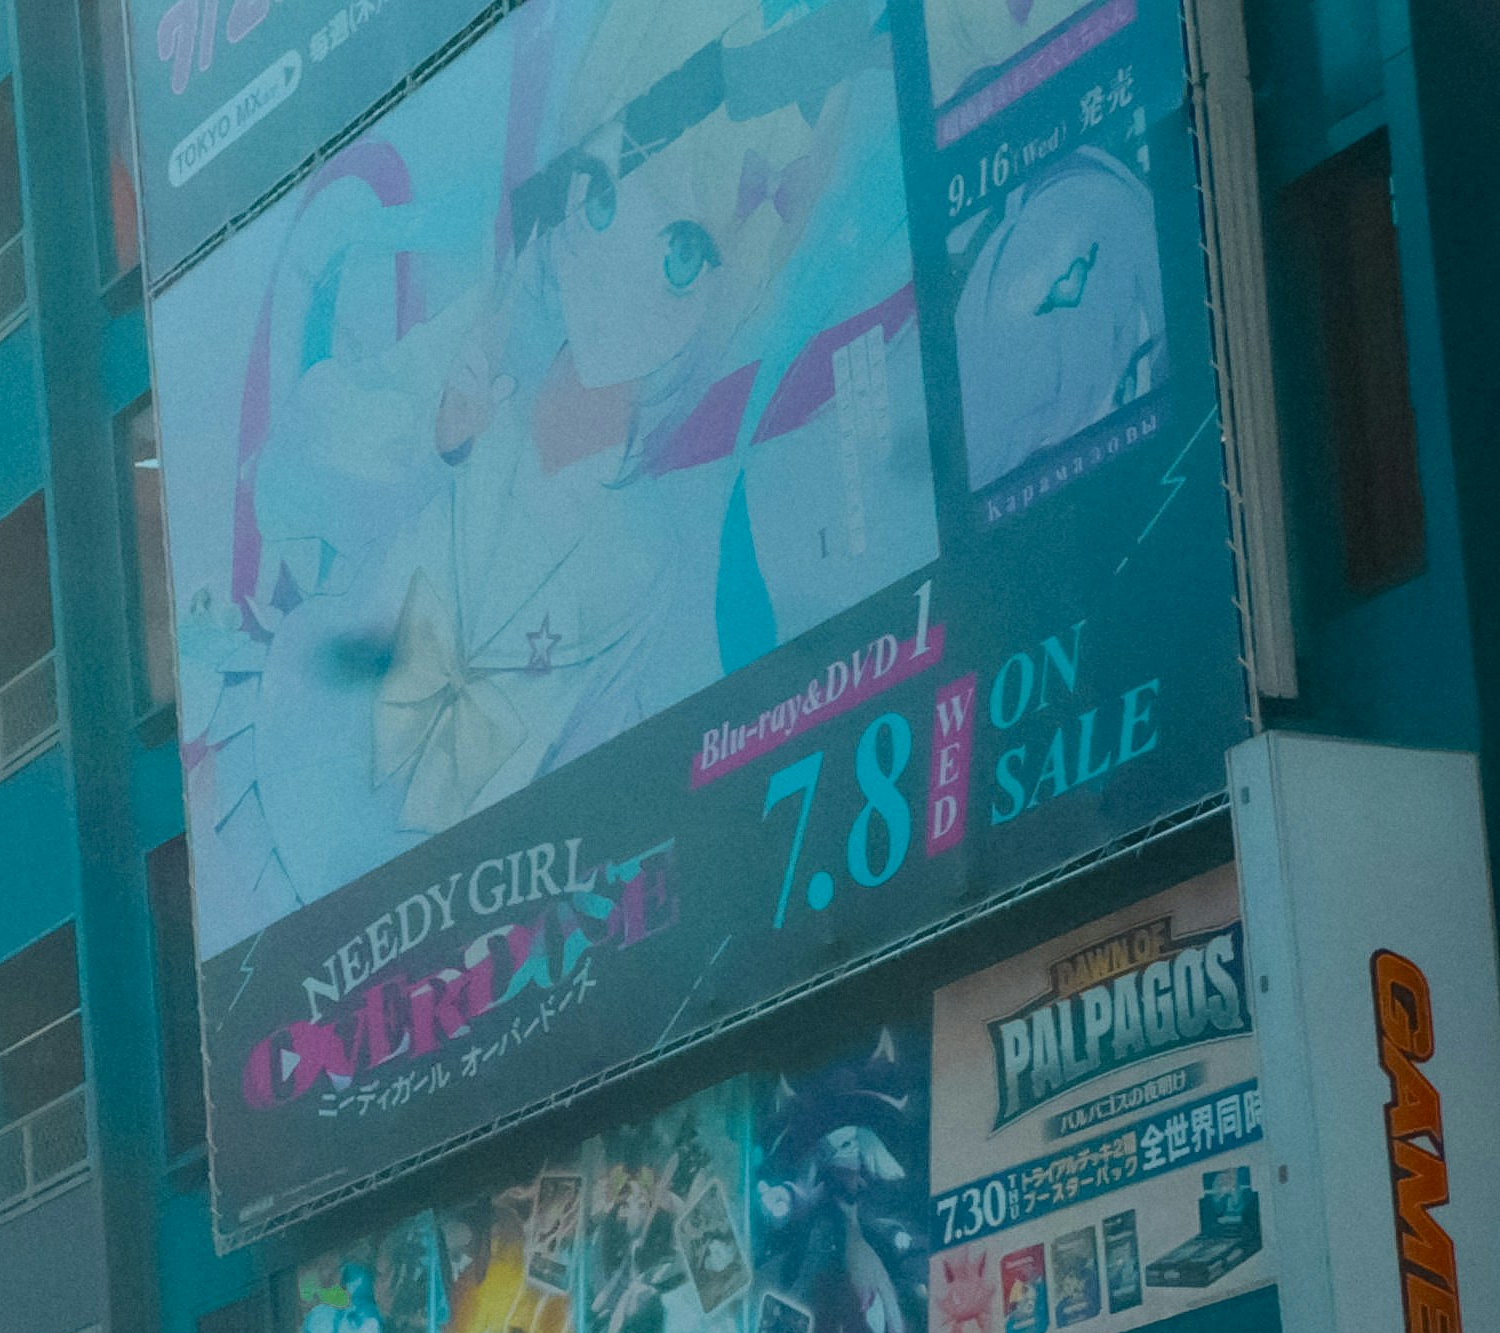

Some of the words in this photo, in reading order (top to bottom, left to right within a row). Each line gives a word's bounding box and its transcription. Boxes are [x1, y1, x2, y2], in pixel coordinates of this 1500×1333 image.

[175, 115, 231, 175] TOKYO
[700, 633, 898, 770] Blu-ray&DVD
[989, 619, 1087, 729] ON
[761, 712, 913, 930] 7.8
[933, 688, 973, 840] WED
[991, 678, 1160, 826] SALE
[302, 873, 463, 1024] NEEDY
[468, 838, 598, 914] GIRL
[1001, 934, 1242, 1117] PALPAGOS
[936, 1180, 1007, 1245] 7.30
